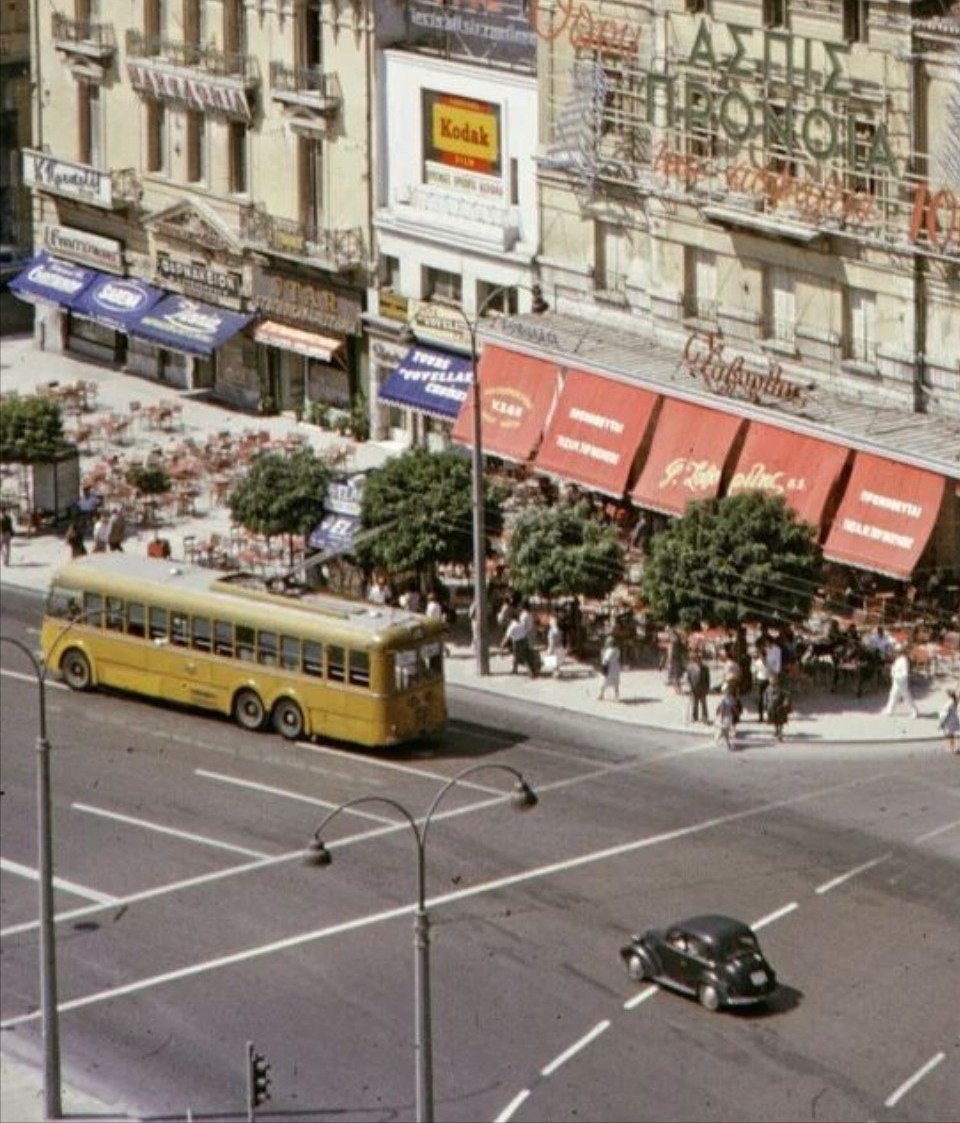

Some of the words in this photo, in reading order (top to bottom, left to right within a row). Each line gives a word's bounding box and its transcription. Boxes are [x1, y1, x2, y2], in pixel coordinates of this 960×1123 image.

[689, 18, 850, 97] ΑΣΠΙΣ
[440, 117, 490, 147] Kodak
[646, 73, 898, 177] ΠΡΟΝΟΙΑ
